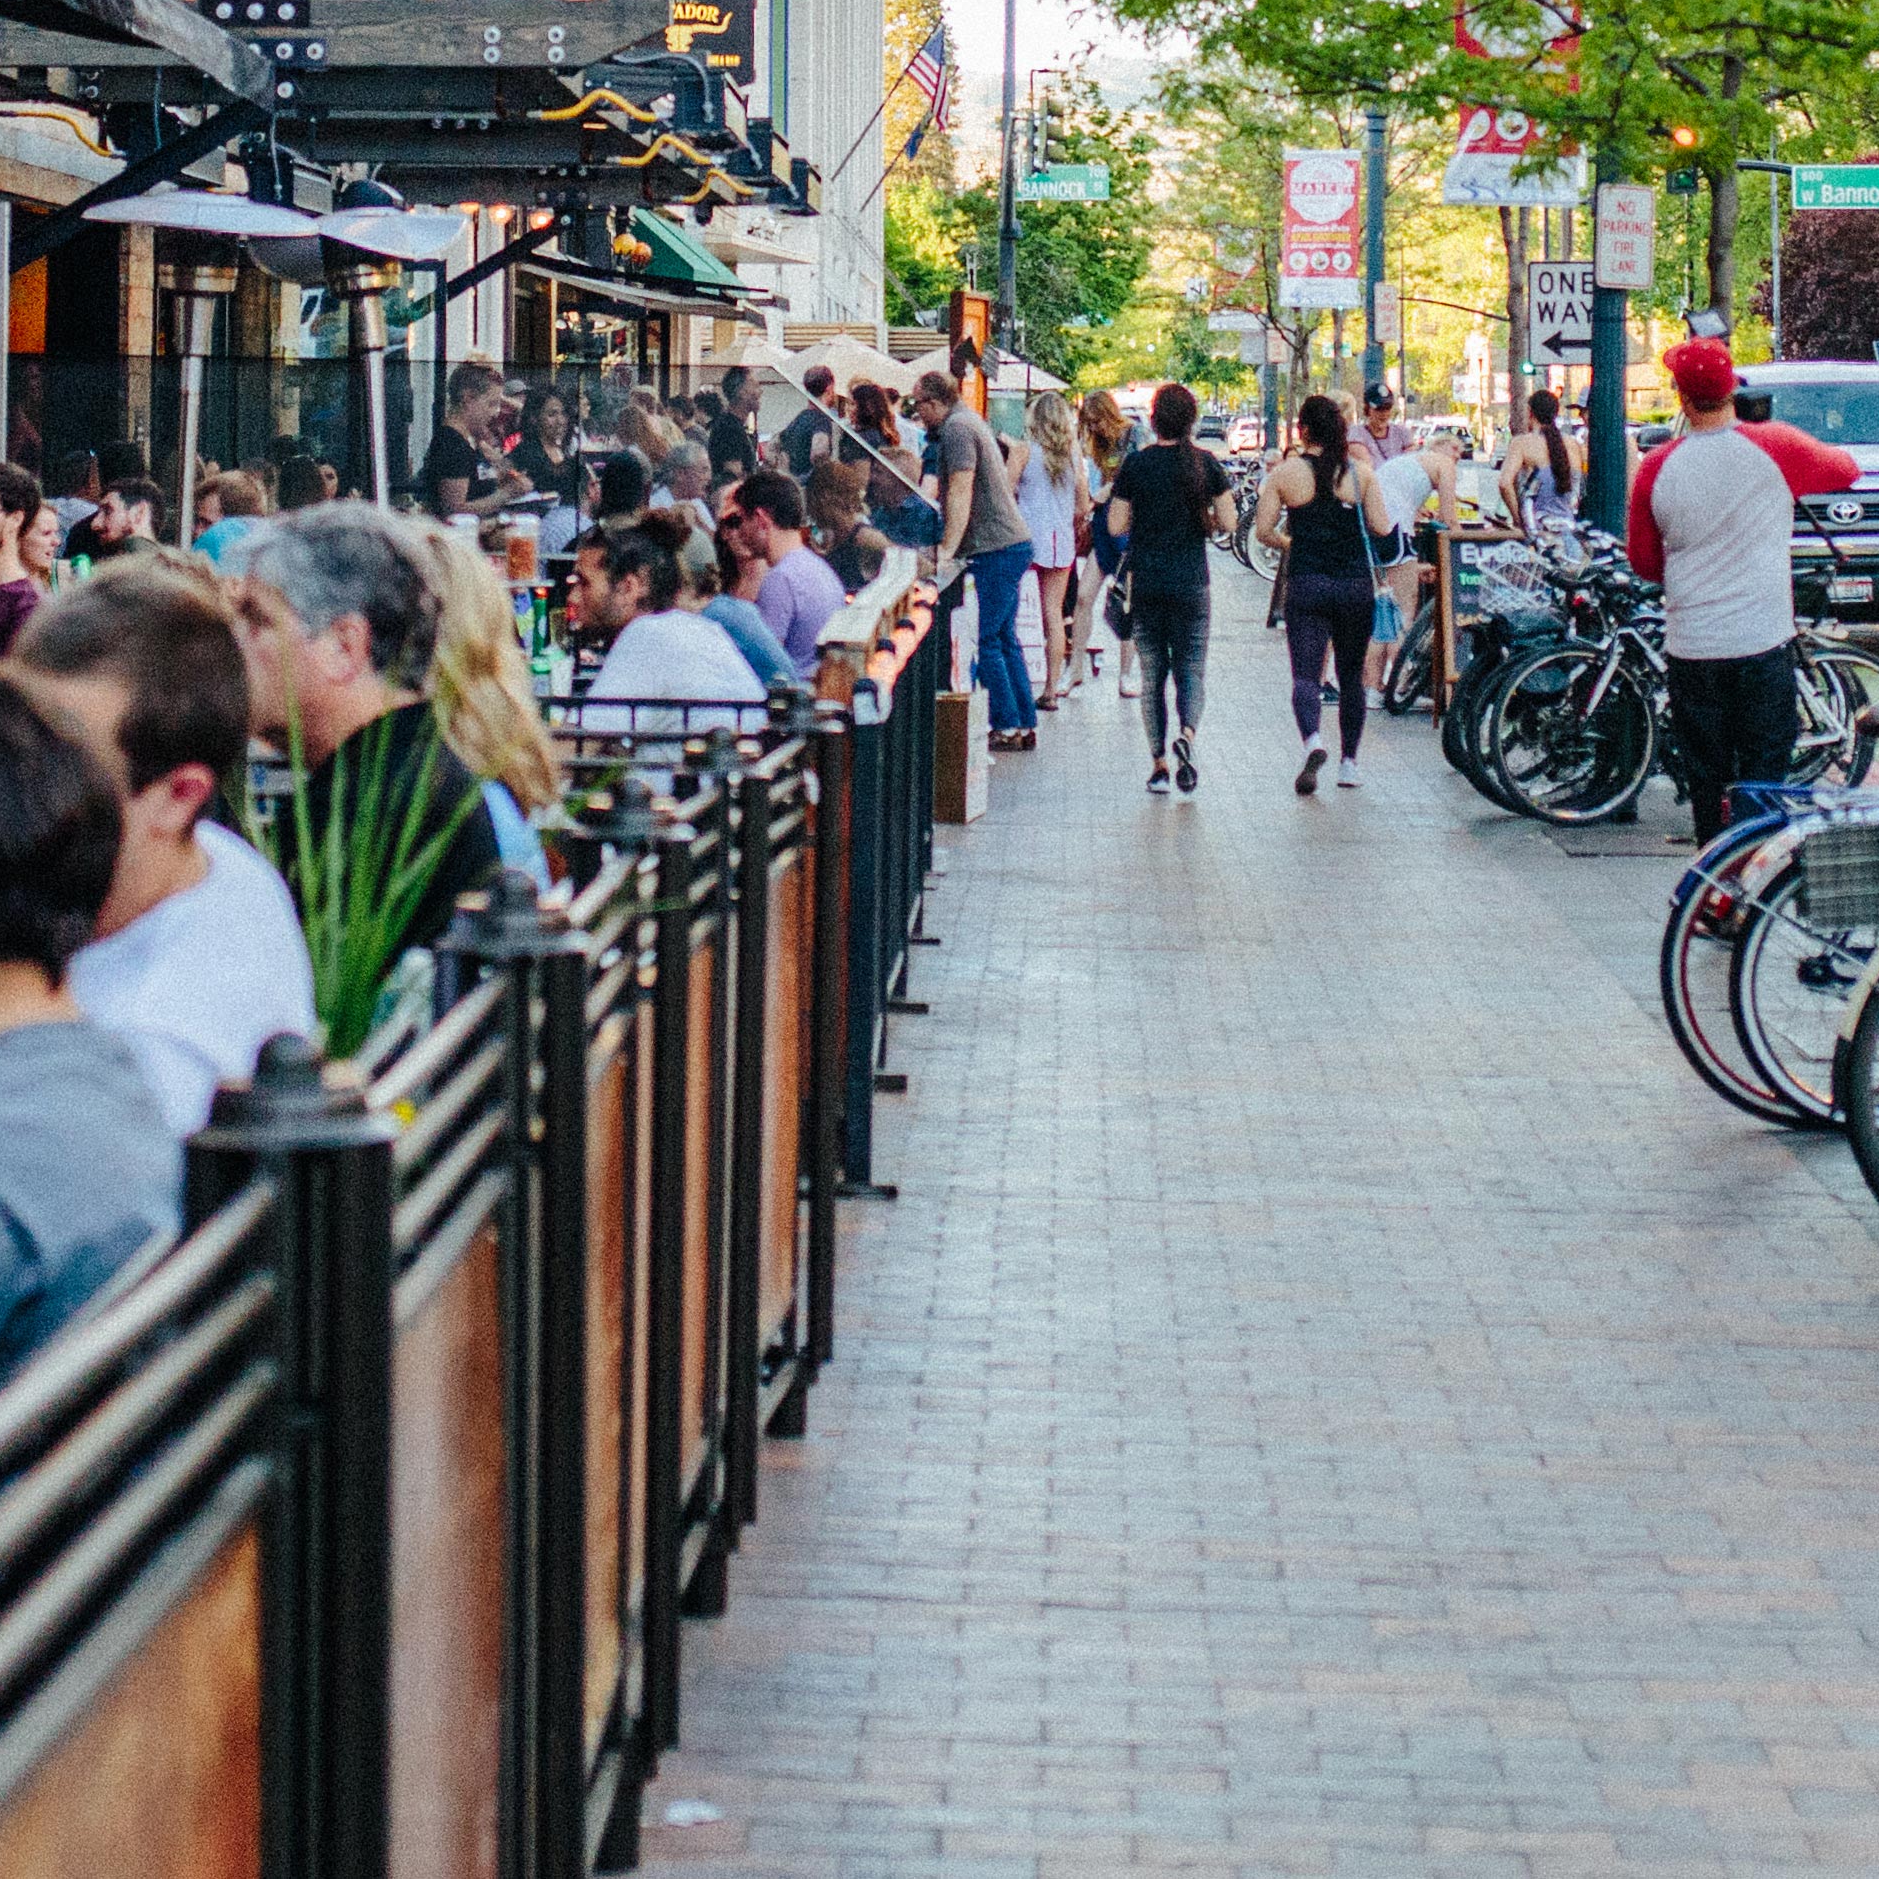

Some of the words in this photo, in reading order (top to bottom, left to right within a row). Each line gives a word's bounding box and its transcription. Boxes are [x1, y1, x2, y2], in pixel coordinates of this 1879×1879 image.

[1022, 181, 1086, 198] BANNOCK
[1617, 200, 1636, 214] NO
[1601, 220, 1650, 236] PARKING
[1613, 241, 1635, 255] FIRE
[1610, 260, 1638, 274] LANE
[1537, 271, 1594, 295] ONE
